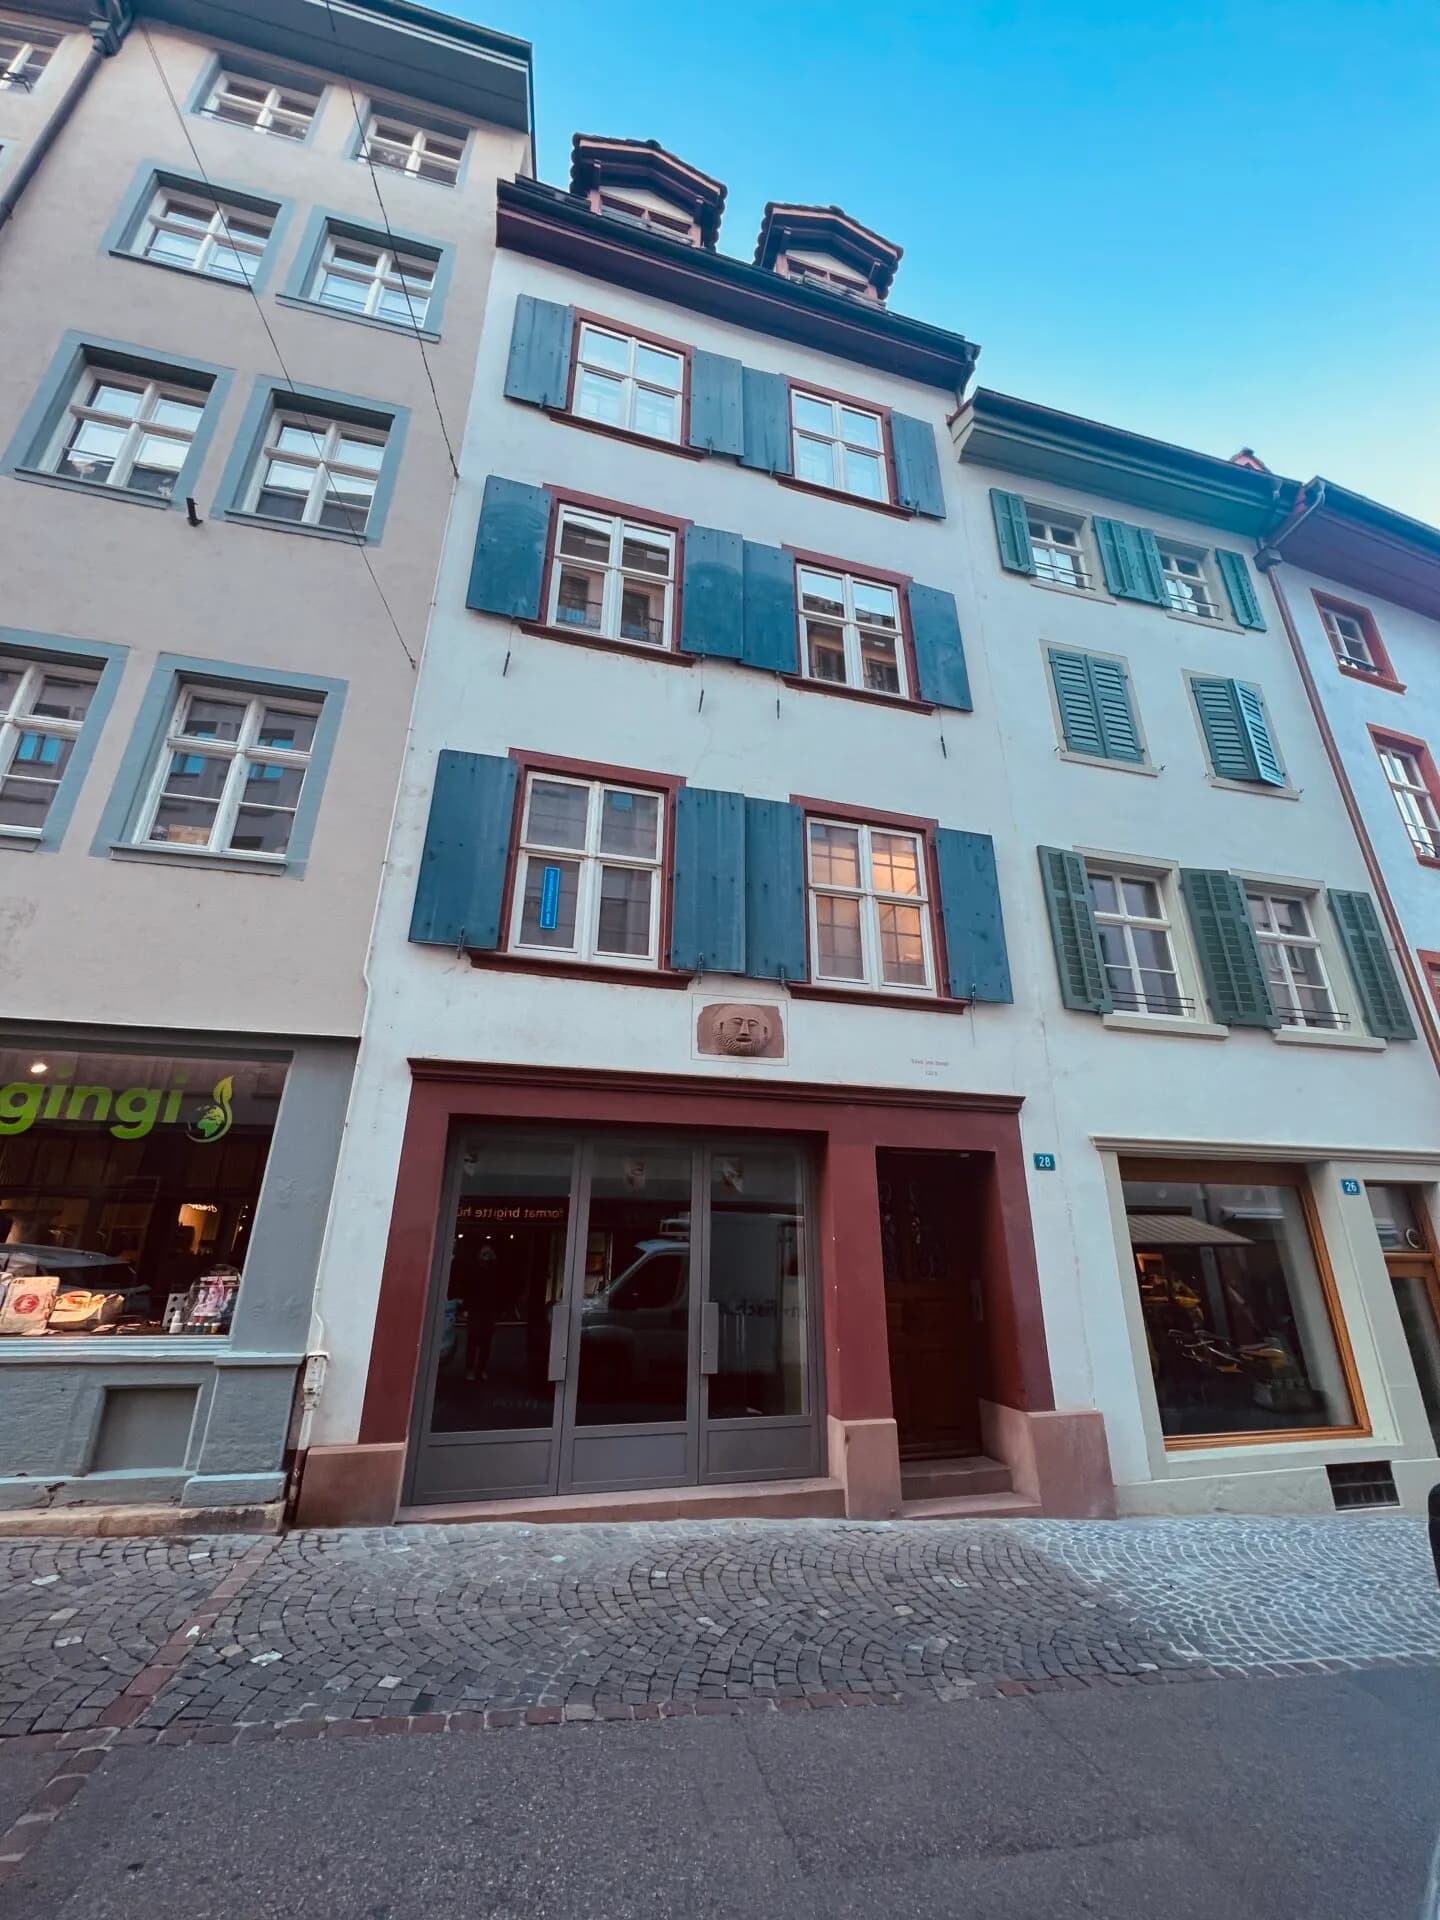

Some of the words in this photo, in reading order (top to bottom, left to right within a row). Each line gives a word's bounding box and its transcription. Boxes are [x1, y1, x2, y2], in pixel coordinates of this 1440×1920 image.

[0, 1063, 189, 1139] gingi
[1039, 1156, 1051, 1167] 28
[1345, 1181, 1357, 1192] 26
